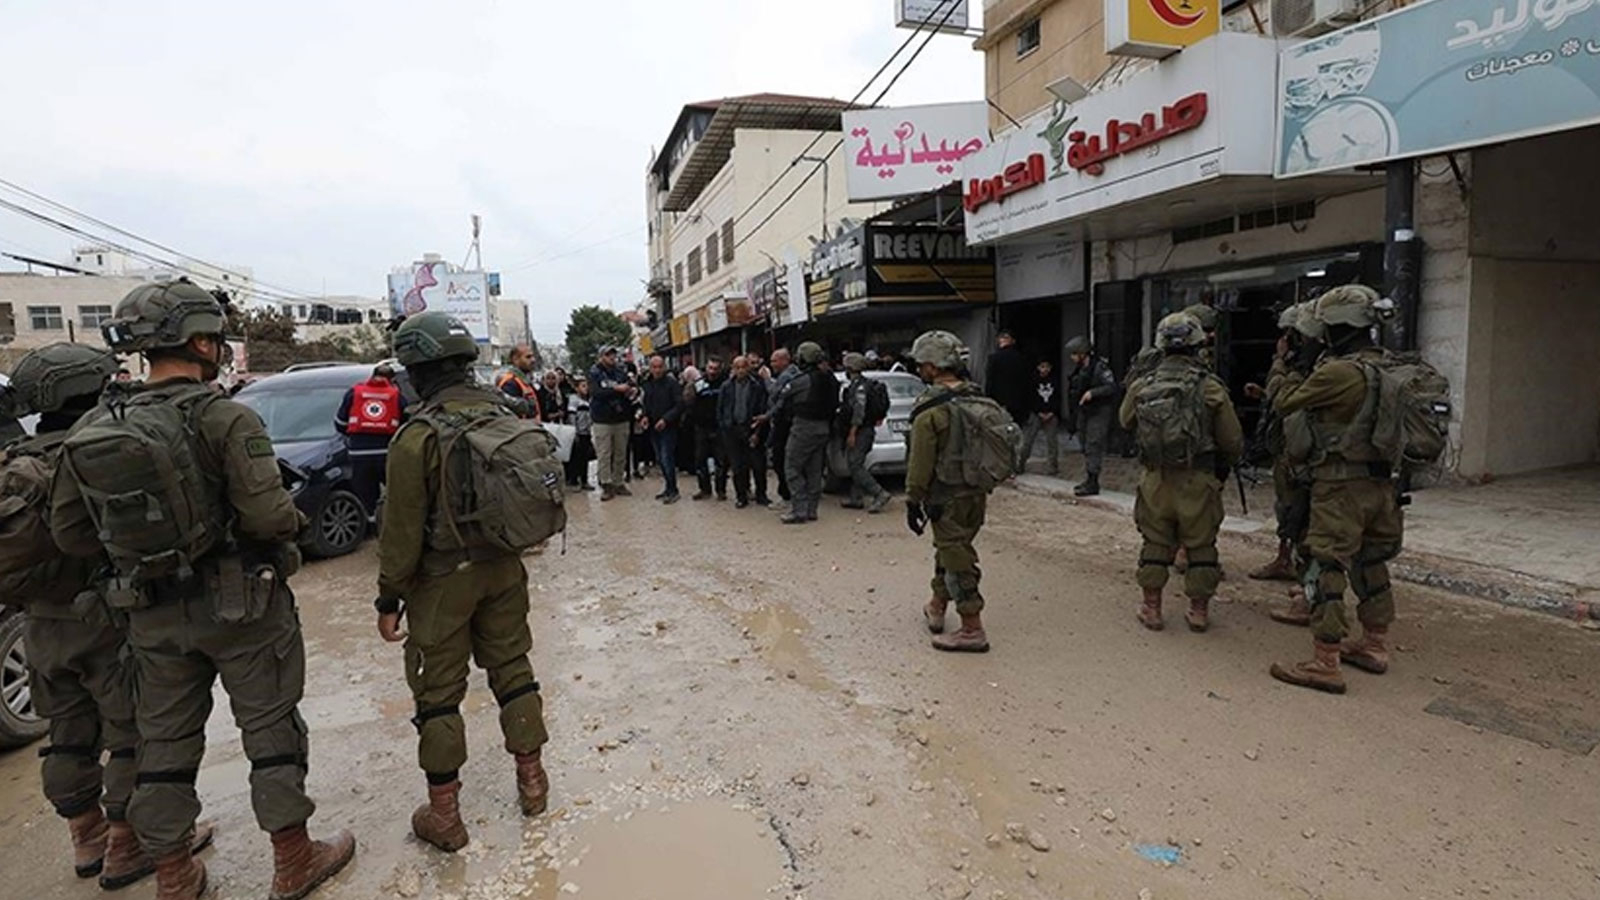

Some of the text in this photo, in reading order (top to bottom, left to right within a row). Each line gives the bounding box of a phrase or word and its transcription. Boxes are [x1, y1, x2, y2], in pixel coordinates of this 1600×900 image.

[1466, 50, 1554, 81] معجنات
[851, 121, 983, 179] صيدلية
[963, 92, 1208, 213] صيدلية الكرمل
